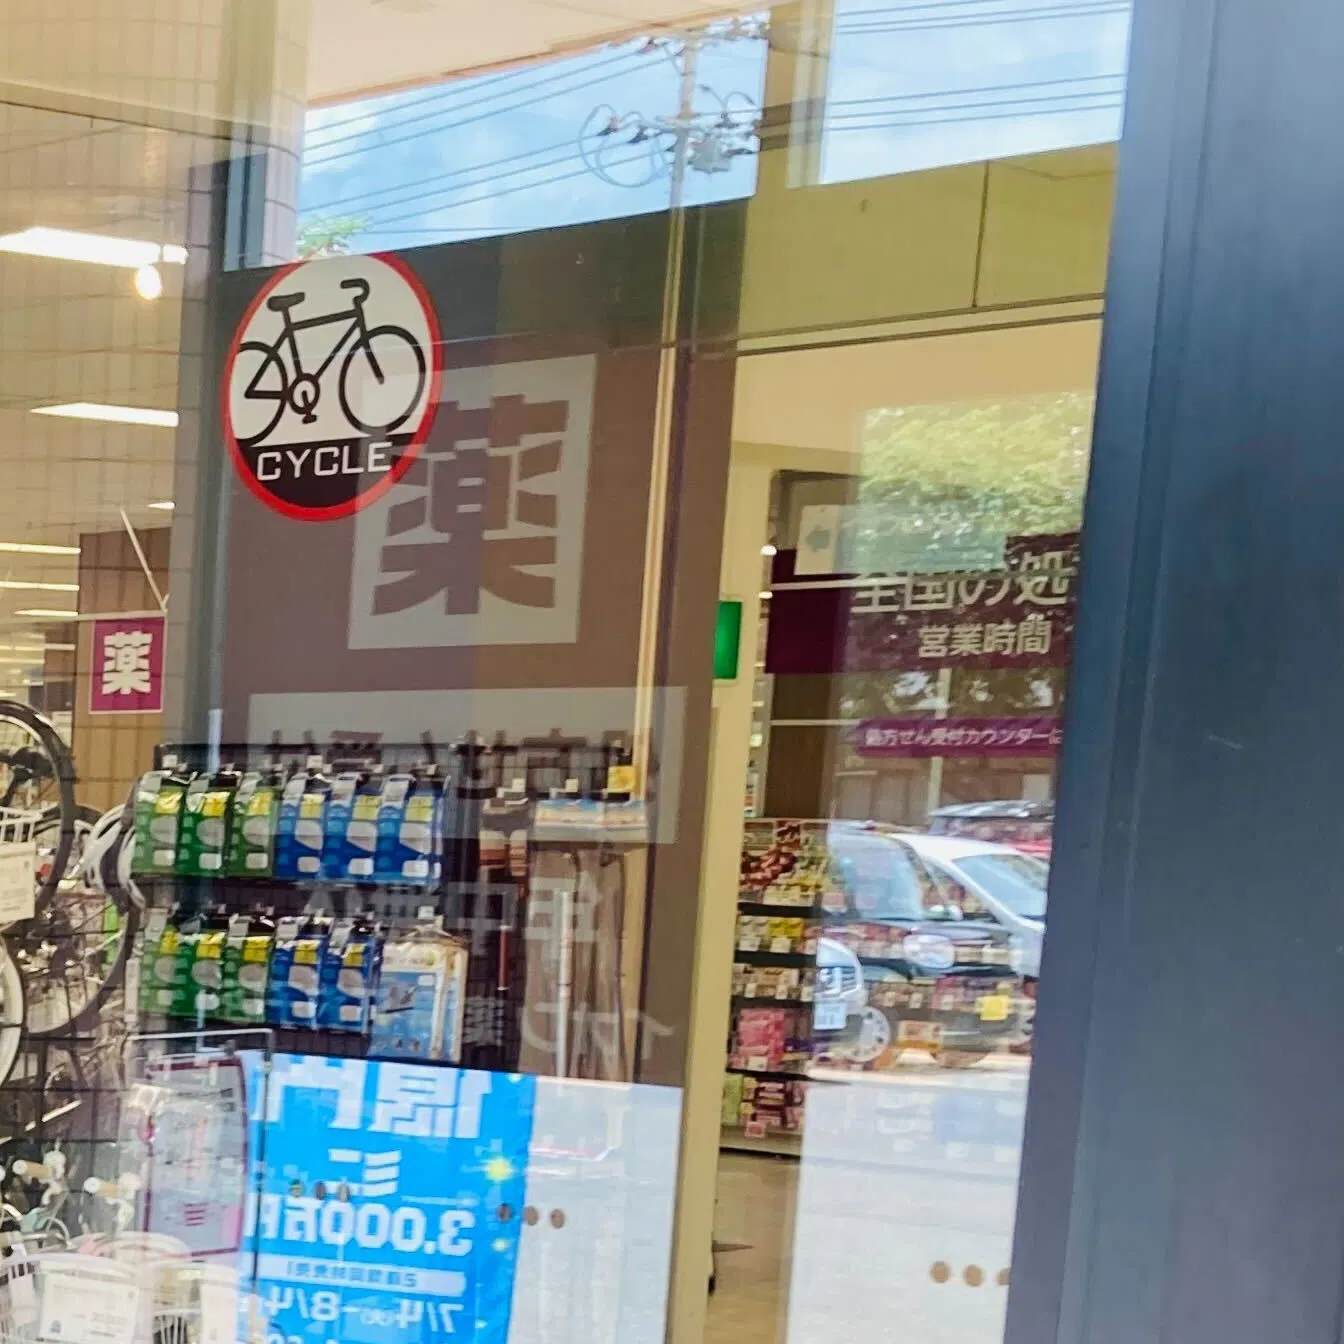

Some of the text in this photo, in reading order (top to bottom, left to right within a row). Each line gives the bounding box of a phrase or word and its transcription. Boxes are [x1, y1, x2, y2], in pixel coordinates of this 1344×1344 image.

[256, 441, 393, 482] CYCLE
[918, 617, 1053, 659] 営業時間
[102, 630, 153, 697] 薬
